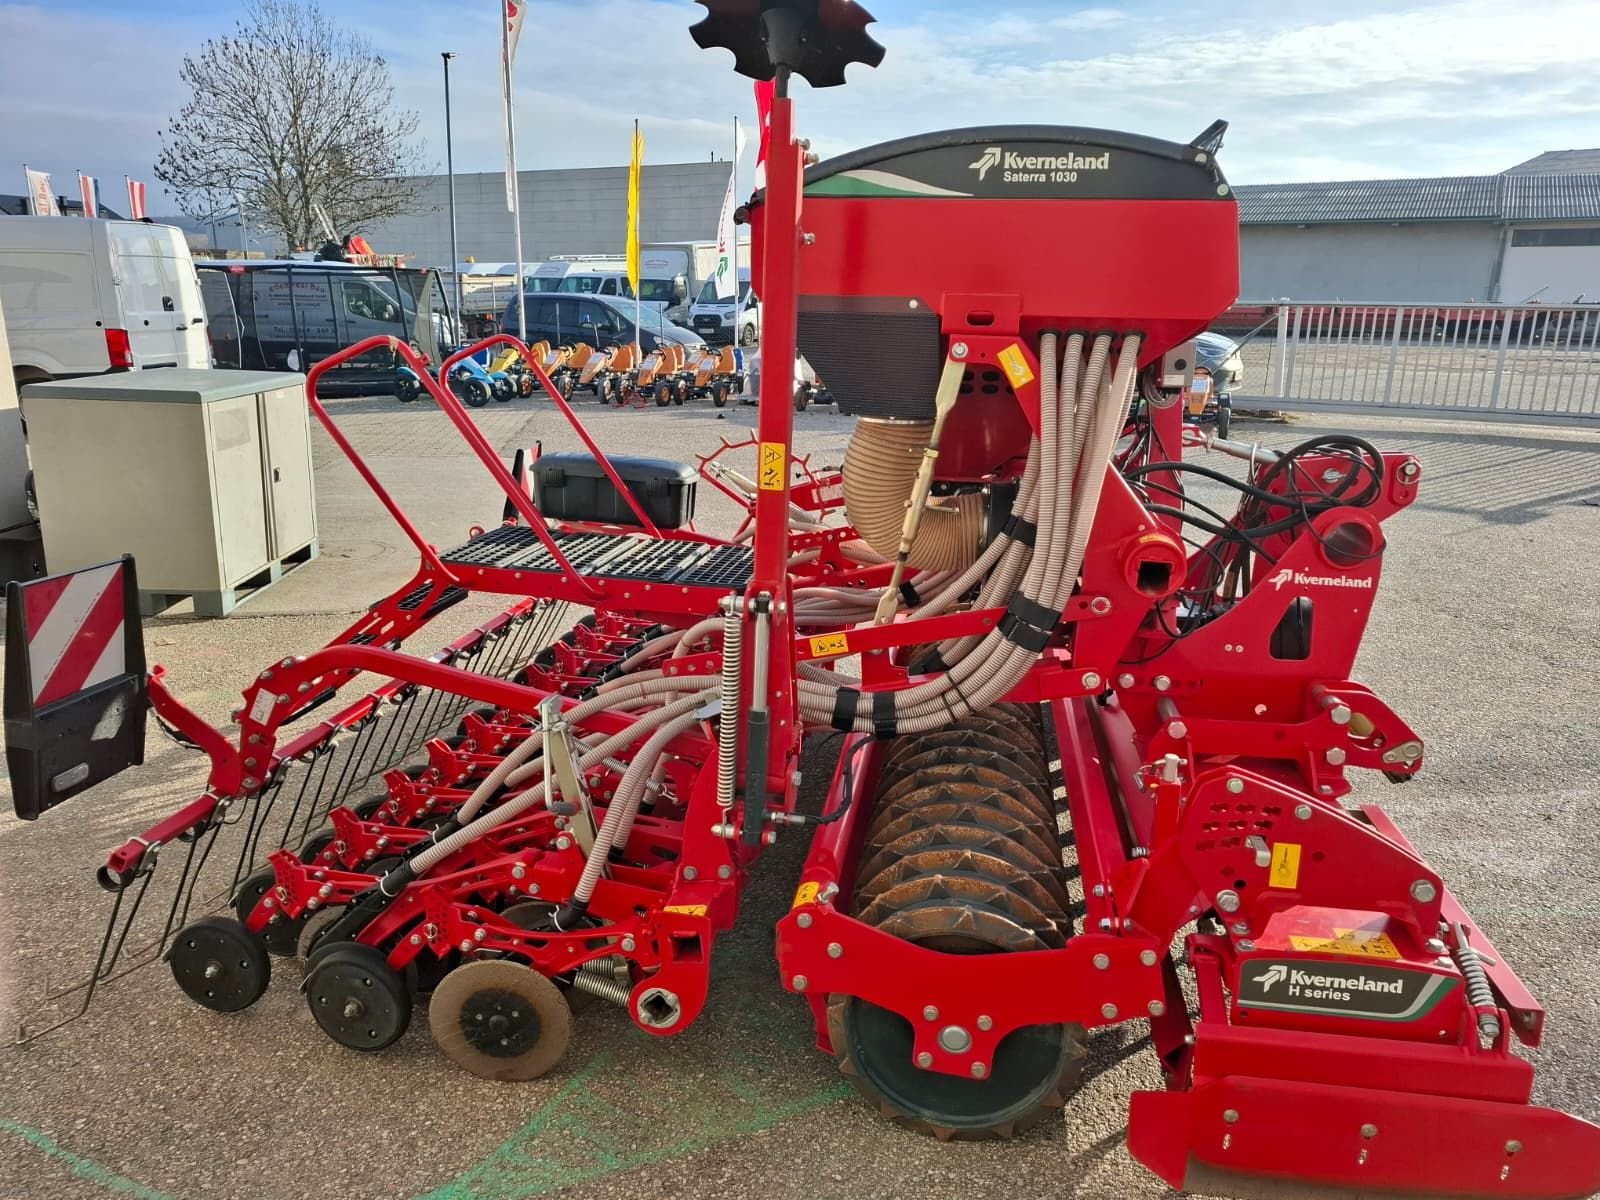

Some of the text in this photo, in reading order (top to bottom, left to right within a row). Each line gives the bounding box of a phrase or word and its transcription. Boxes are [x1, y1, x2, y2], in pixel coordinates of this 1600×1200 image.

[1004, 152, 1110, 169] Kverneland
[1003, 171, 1078, 183] Saterra 1030
[1294, 573, 1372, 588] Kverneland
[1290, 970, 1403, 994] Kverneland
[1288, 985, 1351, 1001] H series
